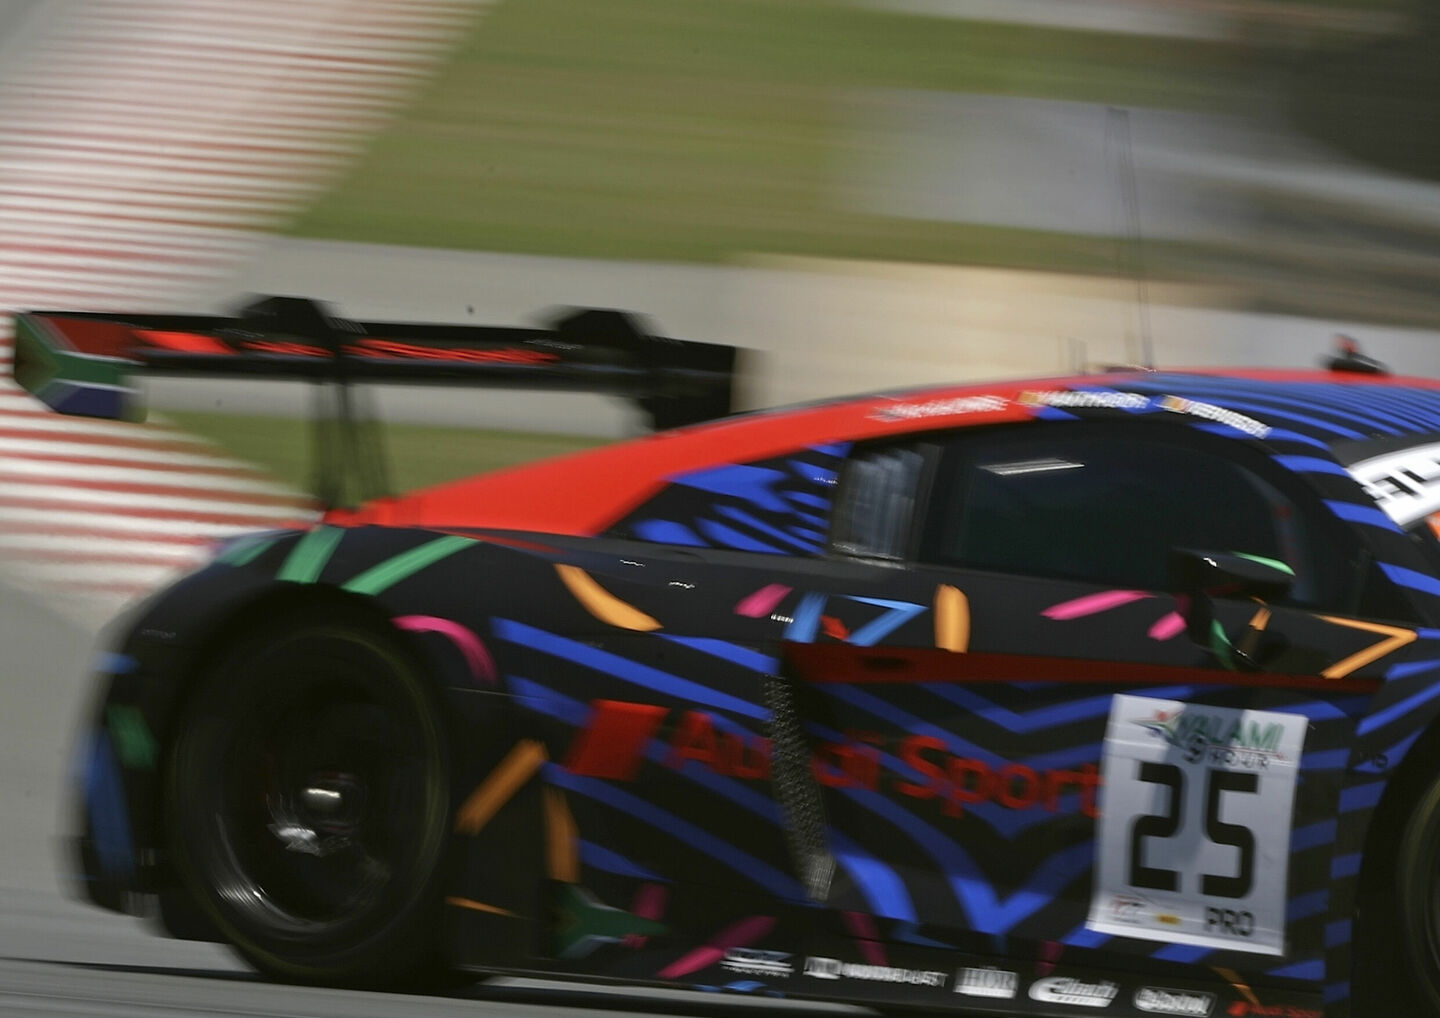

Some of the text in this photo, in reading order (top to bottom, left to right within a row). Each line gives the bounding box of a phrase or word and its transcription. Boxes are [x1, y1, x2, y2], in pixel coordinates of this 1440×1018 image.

[894, 735, 1105, 819] Sport
[1129, 760, 1260, 899] 25
[1204, 906, 1255, 938] PRO
